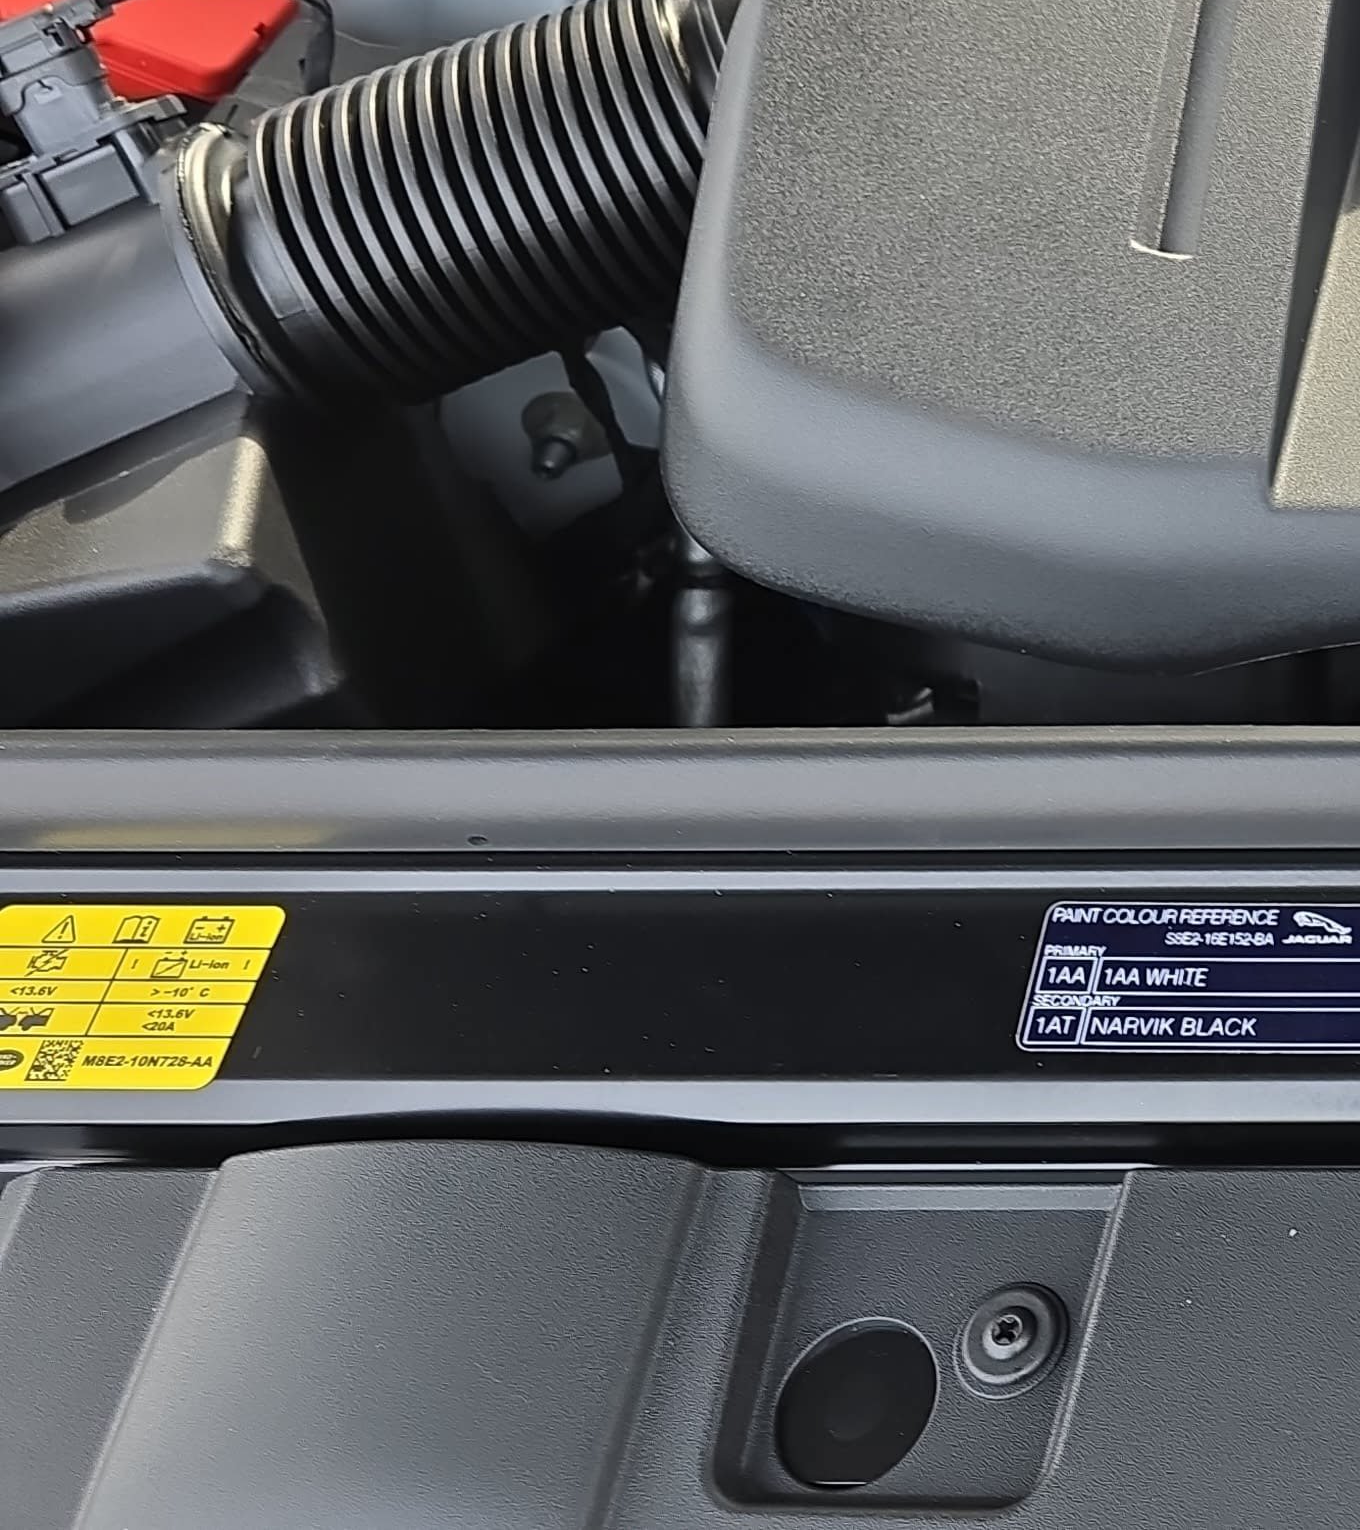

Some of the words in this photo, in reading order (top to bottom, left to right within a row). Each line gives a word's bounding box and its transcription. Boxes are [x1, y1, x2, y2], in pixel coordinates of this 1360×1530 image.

[1052, 907, 1101, 923] PAINT
[1103, 908, 1178, 924] COLOUR
[1180, 909, 1280, 925] REFERENCE
[1282, 935, 1353, 945] JAGUAR
[1044, 945, 1107, 957] PRIMARY
[189, 959, 229, 969] Li-ion
[1048, 966, 1085, 984] 1AA
[1105, 967, 1140, 985] 1AA
[1146, 968, 1209, 987] WHITE
[10, 986, 58, 996] <13.6V
[1032, 994, 1121, 1006] SECONDARY
[147, 1009, 195, 1019] <13.6V
[142, 1022, 175, 1032] <20A
[1036, 1016, 1076, 1034] 1AT
[1090, 1017, 1175, 1036] NARVIK
[1180, 1017, 1256, 1037] BLACK
